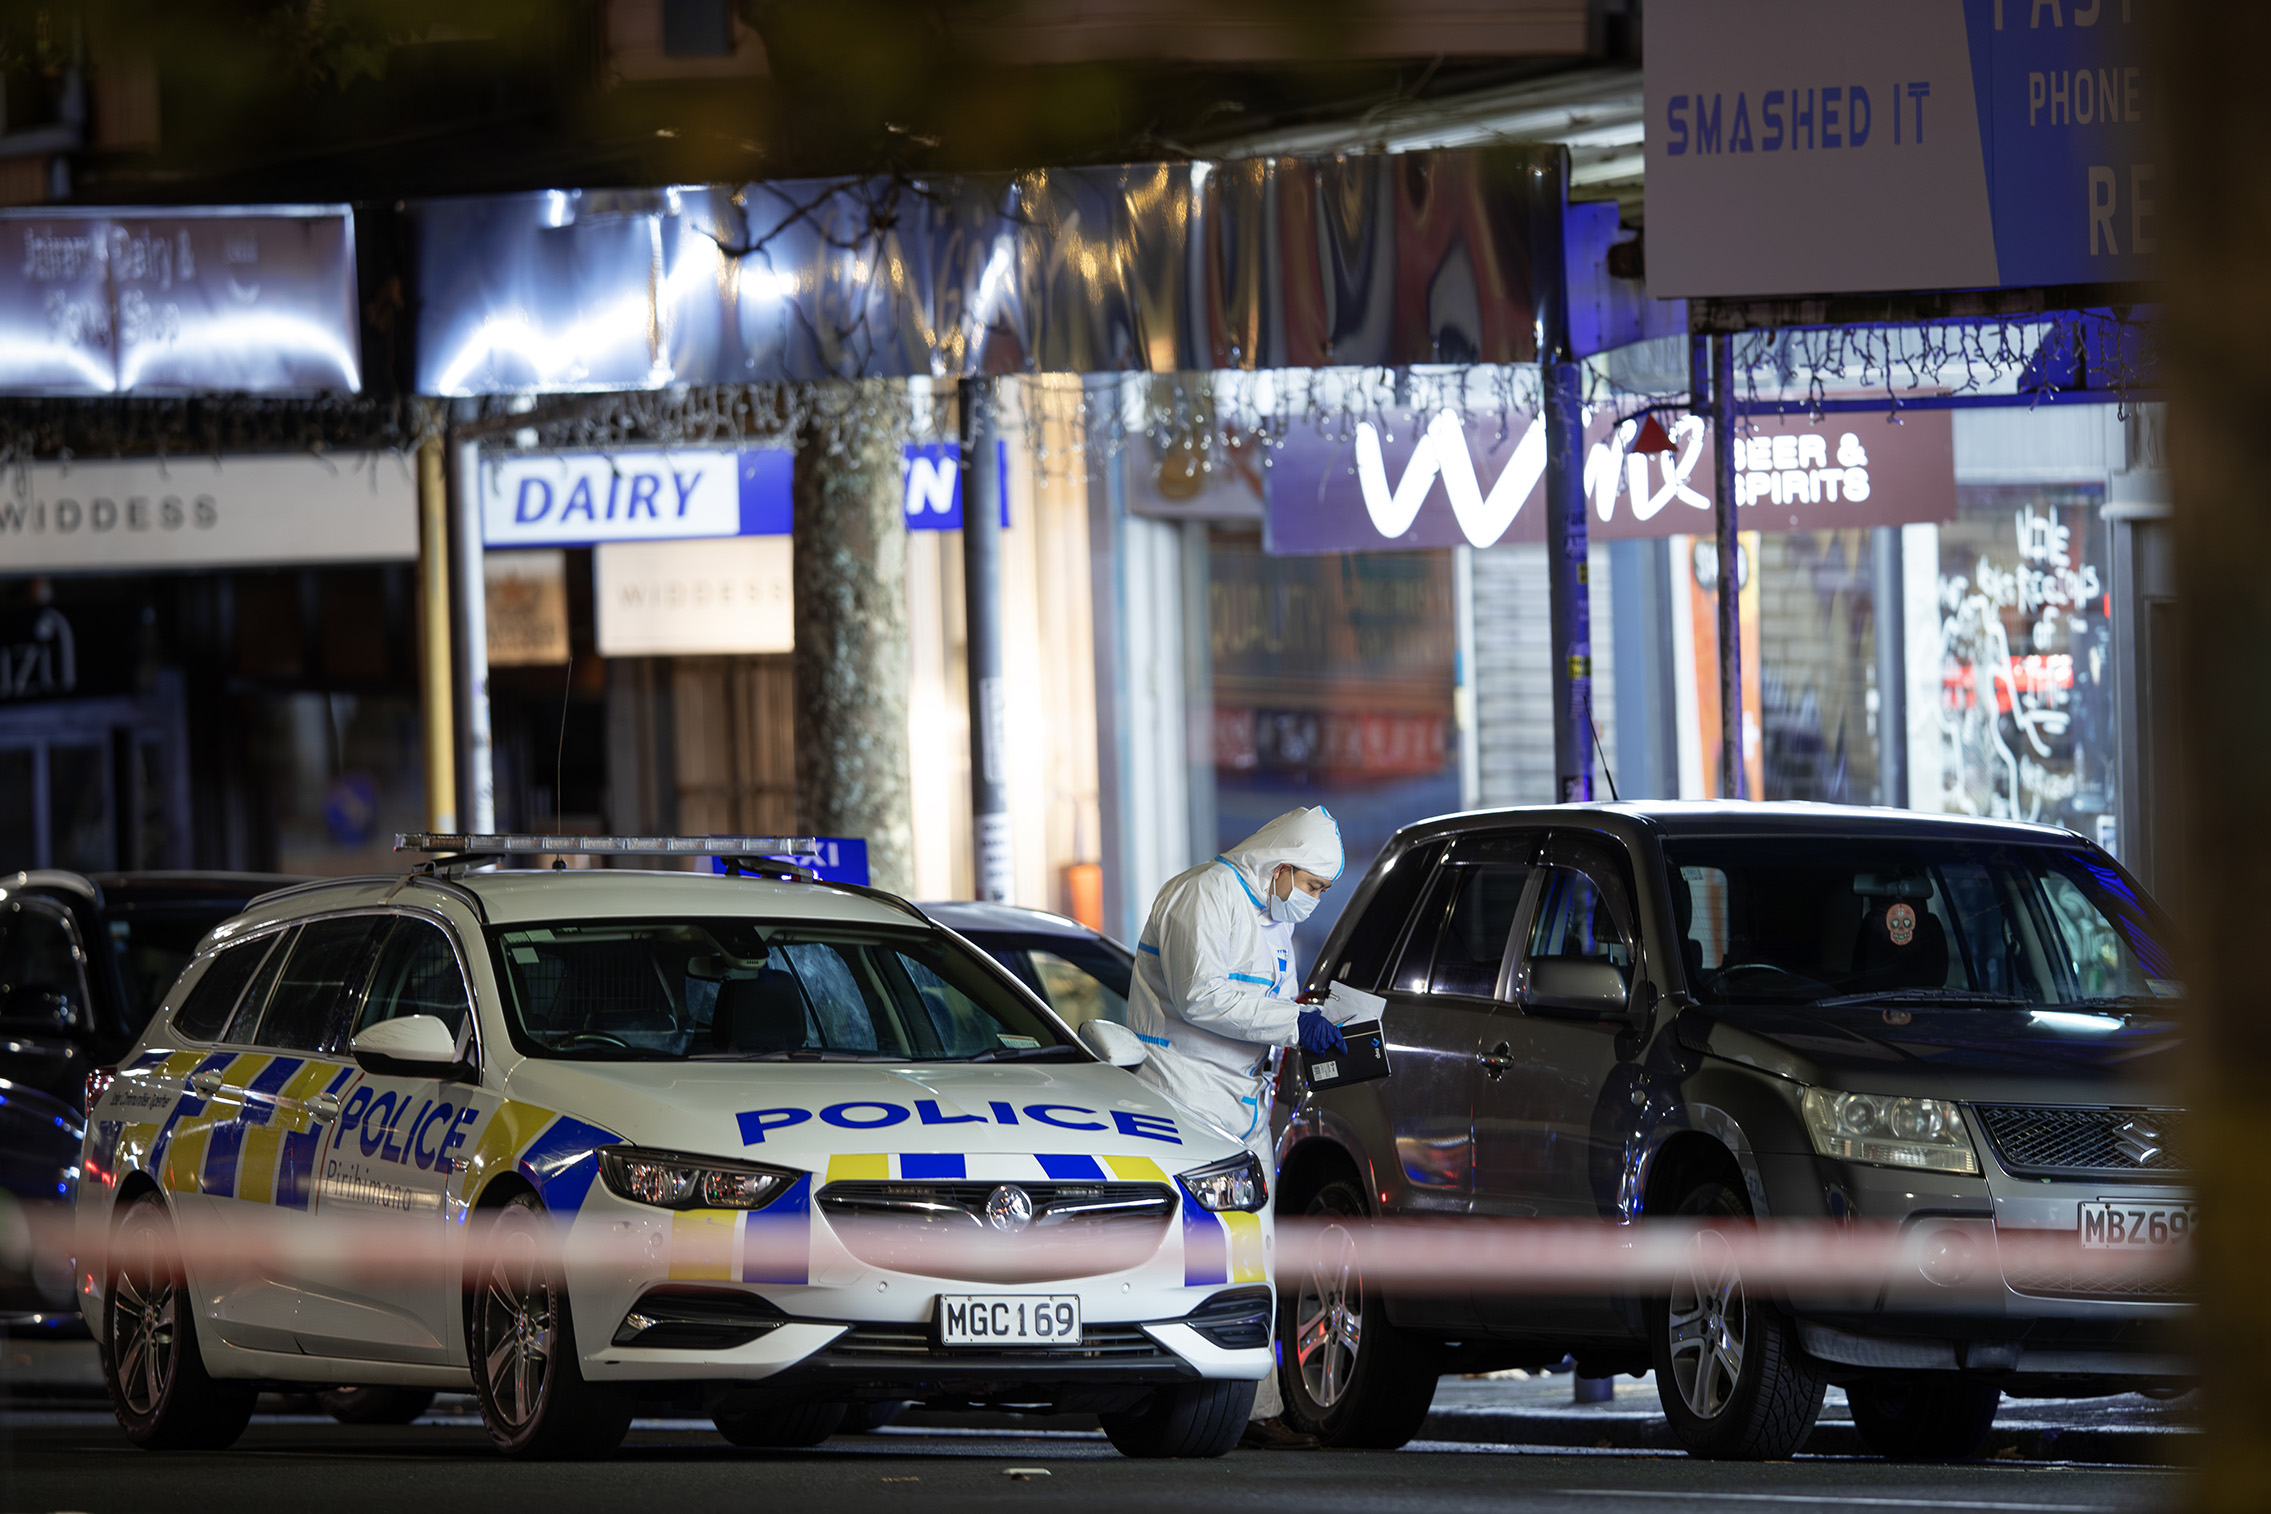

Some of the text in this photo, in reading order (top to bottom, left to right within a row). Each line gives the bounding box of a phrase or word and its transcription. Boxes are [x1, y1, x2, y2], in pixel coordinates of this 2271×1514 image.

[1666, 81, 1930, 156] SMASHED IT
[2029, 67, 2141, 127] PHONE
[1837, 432, 1869, 467] &
[514, 468, 705, 525] DAIRY
[1355, 407, 1711, 549] Wne
[0, 493, 220, 534] WIDDESS
[333, 1086, 480, 1175] POLICE
[736, 1100, 1183, 1147] POLICE
[326, 1160, 413, 1212] Pirihimana
[947, 1302, 1075, 1338] MGC169
